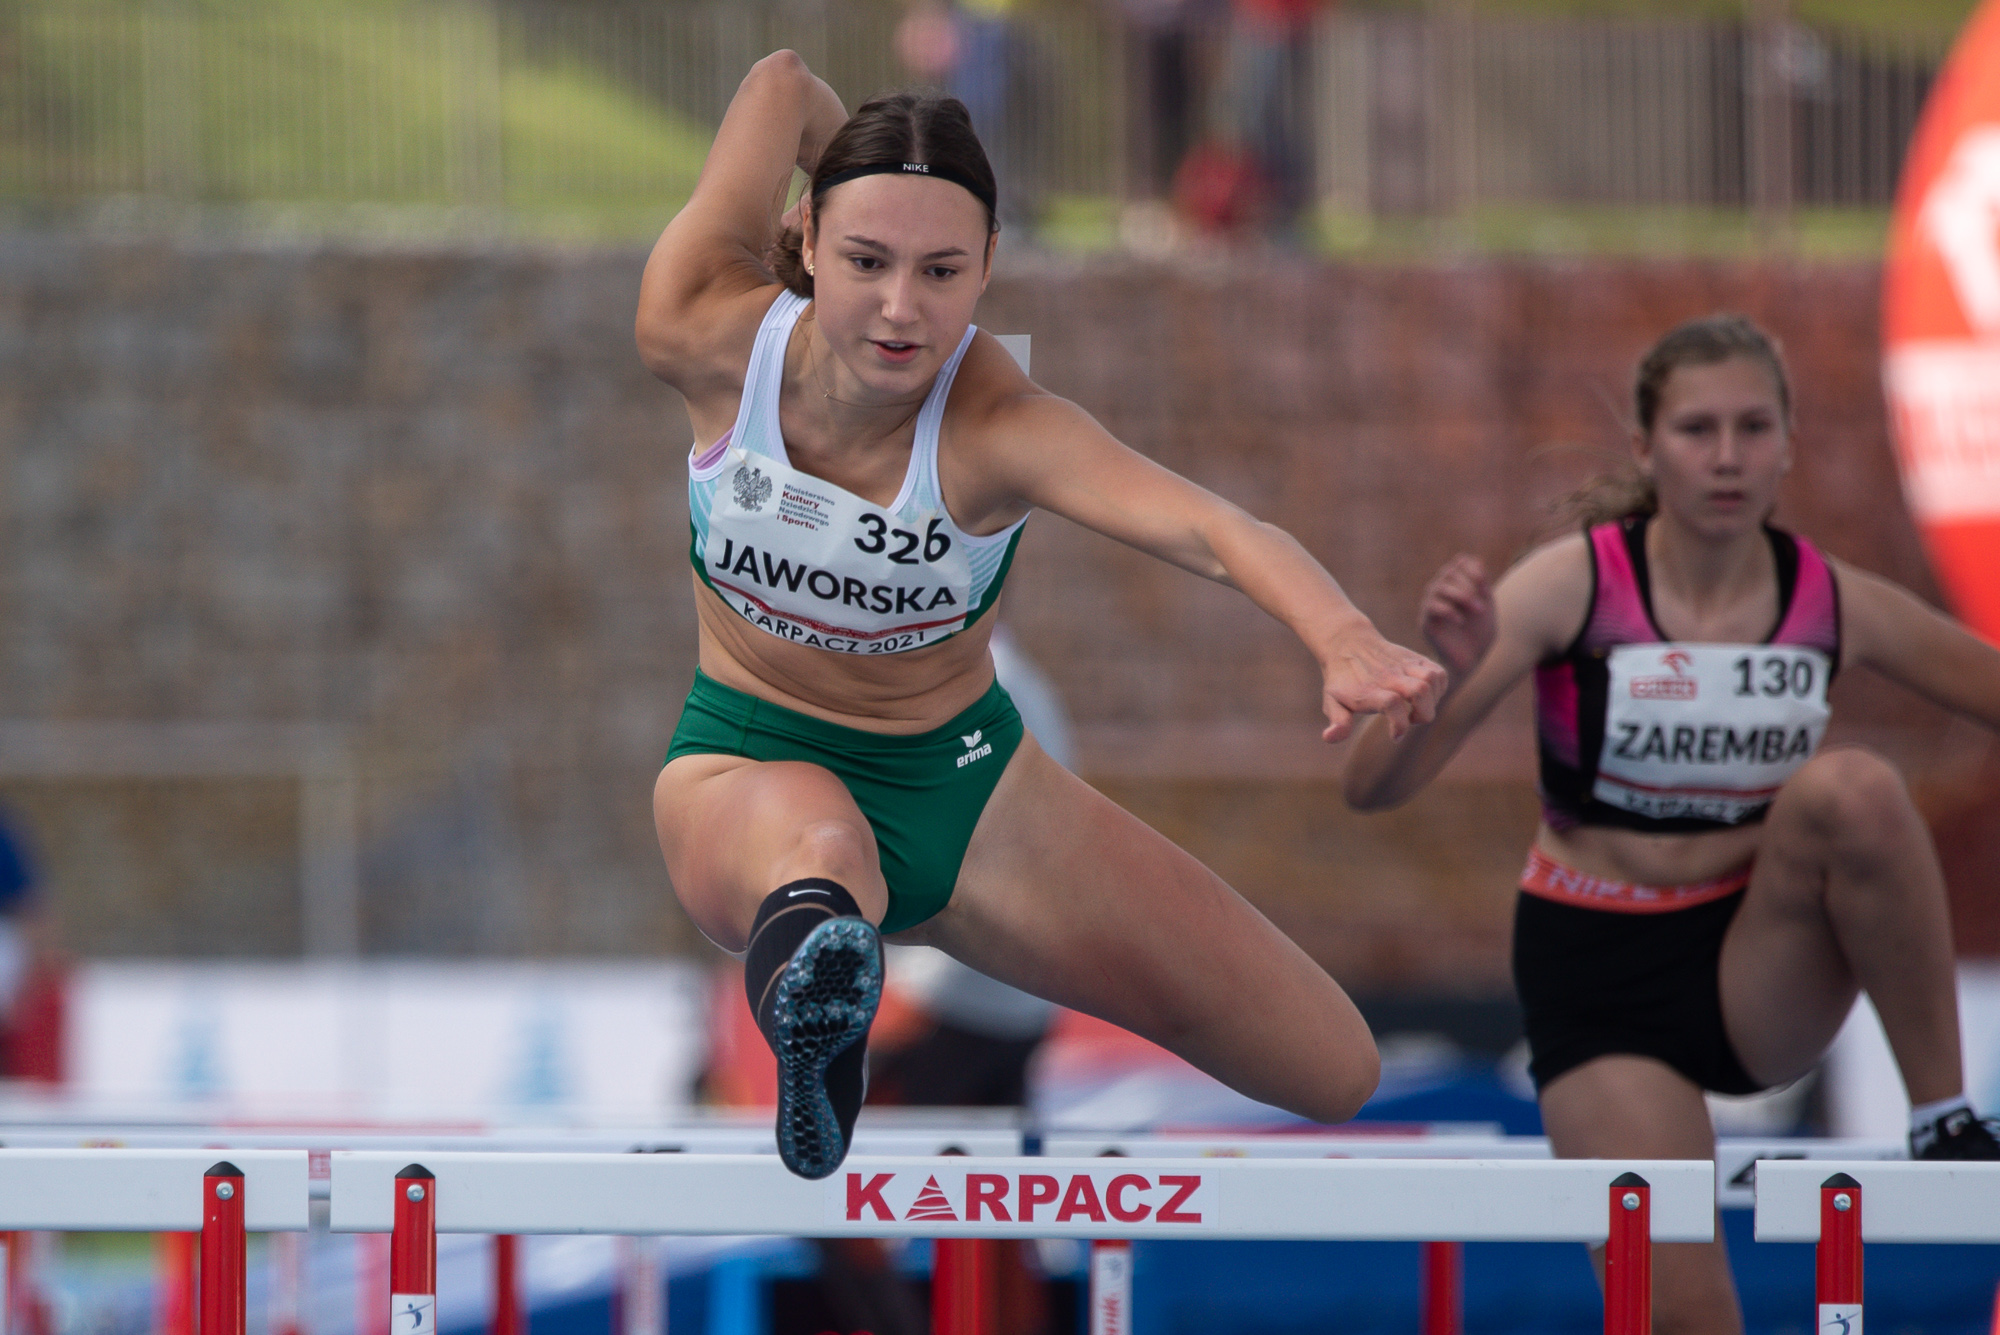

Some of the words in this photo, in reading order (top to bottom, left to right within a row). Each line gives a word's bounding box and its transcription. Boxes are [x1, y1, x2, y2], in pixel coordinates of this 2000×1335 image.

[903, 163, 929, 173] NIKE
[782, 490, 820, 510] Kultury
[784, 483, 835, 506] Ministerstwo
[853, 512, 951, 565] 326
[715, 538, 957, 615] JAWORSKA
[743, 602, 860, 653] KARPACZ
[868, 631, 924, 653] 2021
[1732, 657, 1814, 698] 130
[956, 743, 992, 768] erima
[1614, 722, 1812, 765] ZAREMBA
[846, 1172, 1202, 1224] KARPACZ
